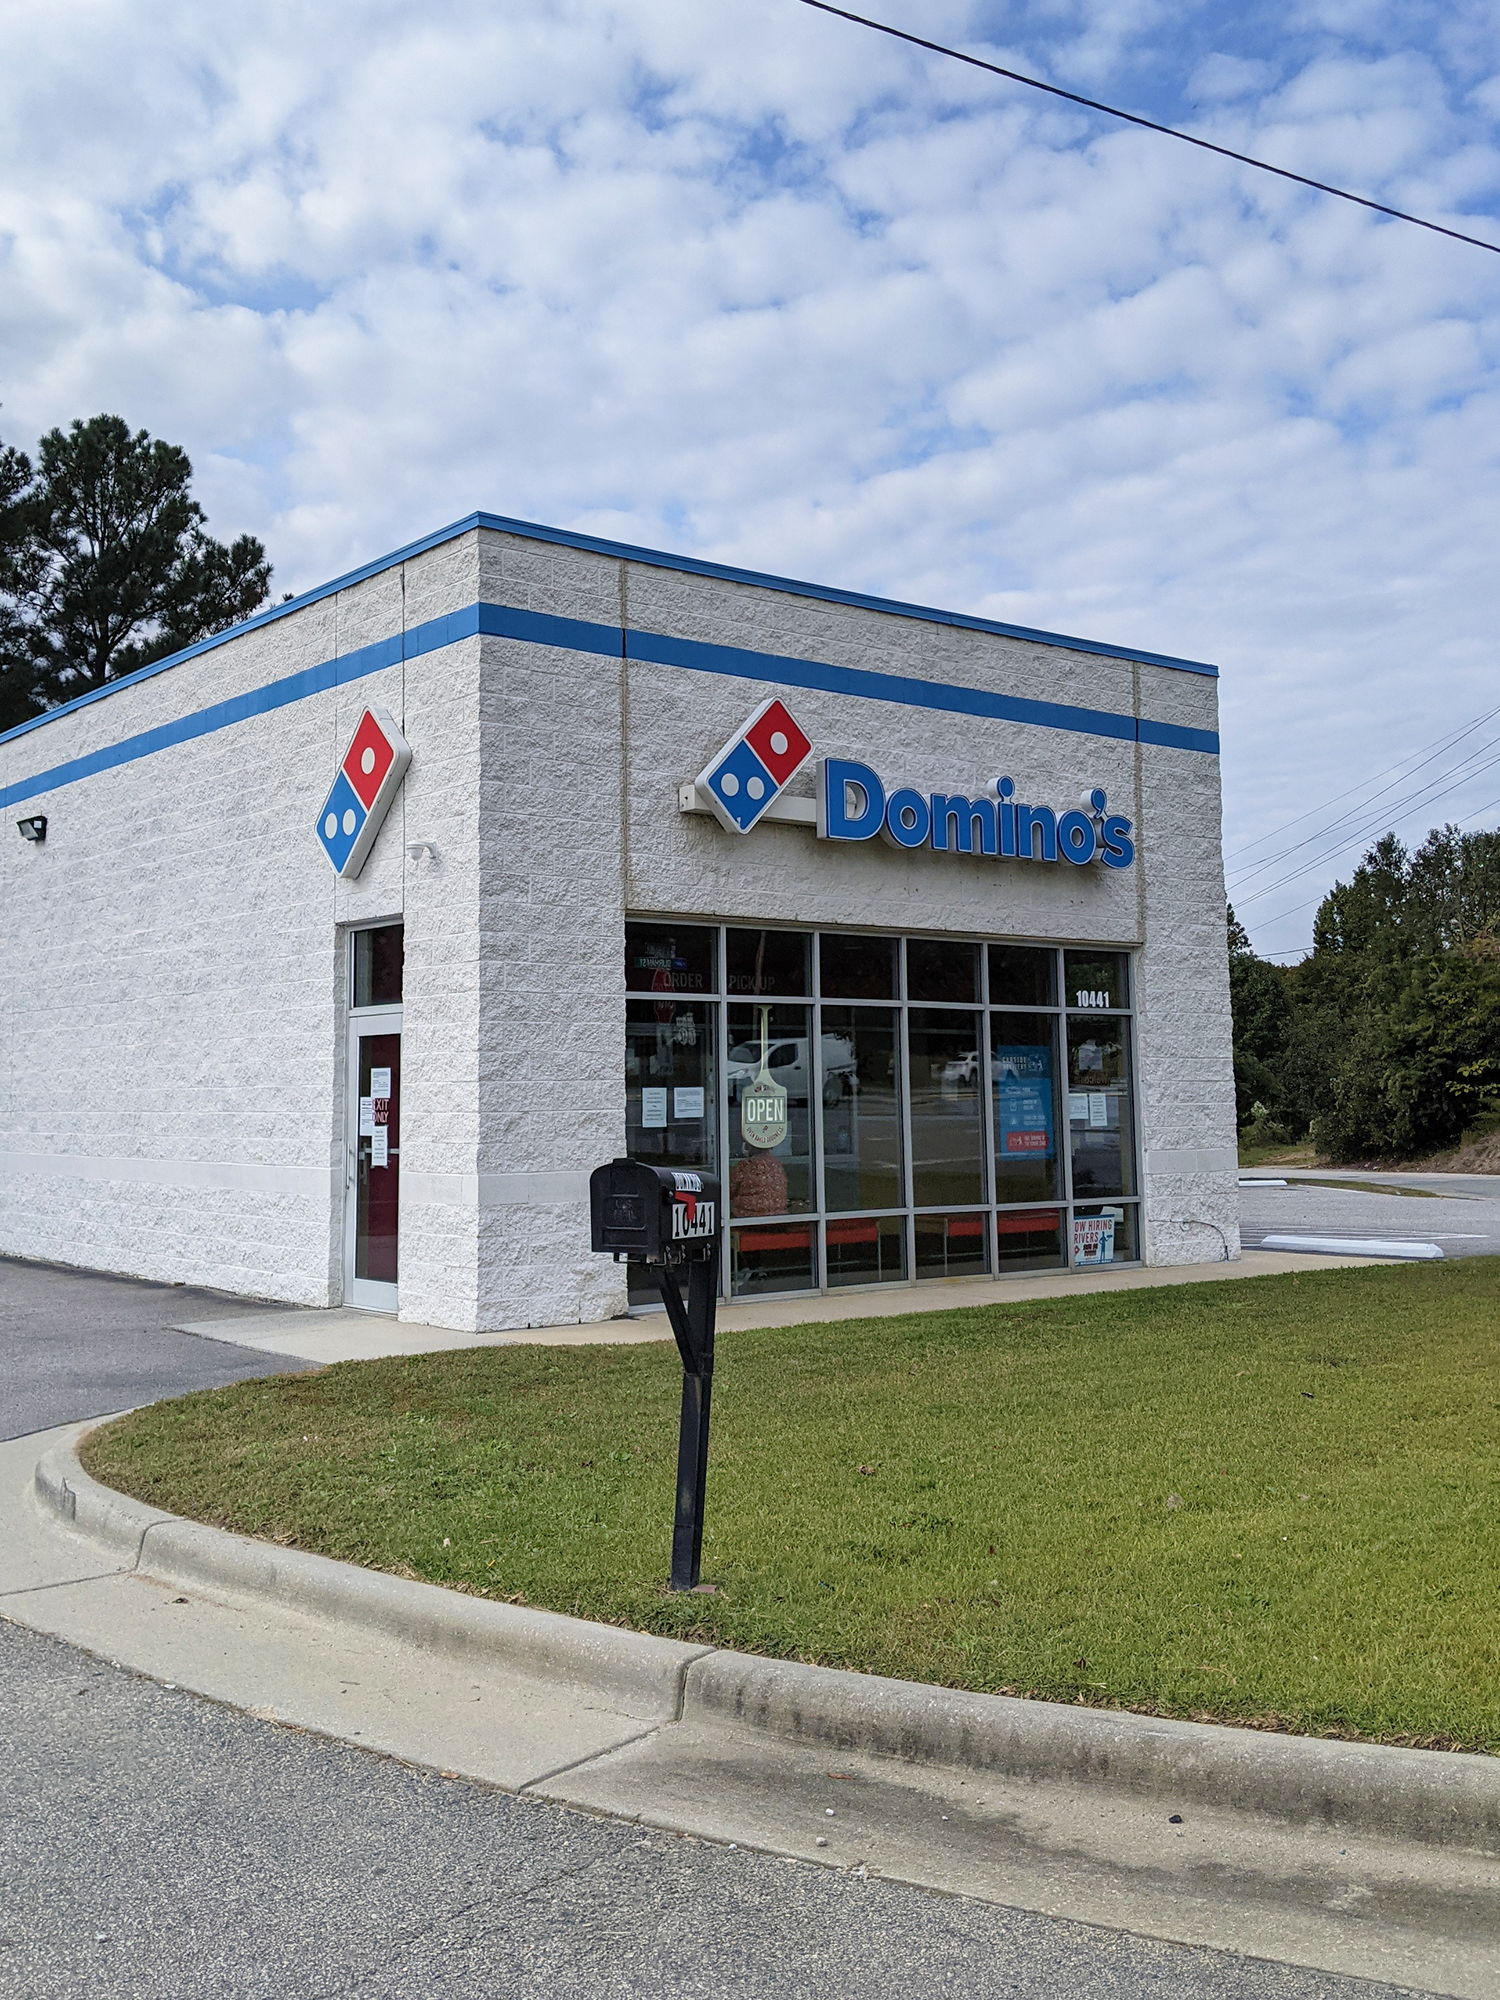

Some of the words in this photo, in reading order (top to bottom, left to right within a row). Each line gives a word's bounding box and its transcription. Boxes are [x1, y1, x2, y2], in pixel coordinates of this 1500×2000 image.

[818, 757, 1135, 869] Domino's
[663, 972, 703, 988] ORDER
[1076, 990, 1110, 1008] 10441
[372, 1099, 389, 1111] EXIT
[747, 1099, 783, 1122] OPEN
[372, 1111, 389, 1123] ONLY
[673, 1173, 701, 1190] DOMINOS
[674, 1204, 713, 1238] 10441
[1074, 1221, 1086, 1232] OW
[1088, 1219, 1113, 1231] HIRING
[1073, 1232, 1099, 1244] RIVERS
